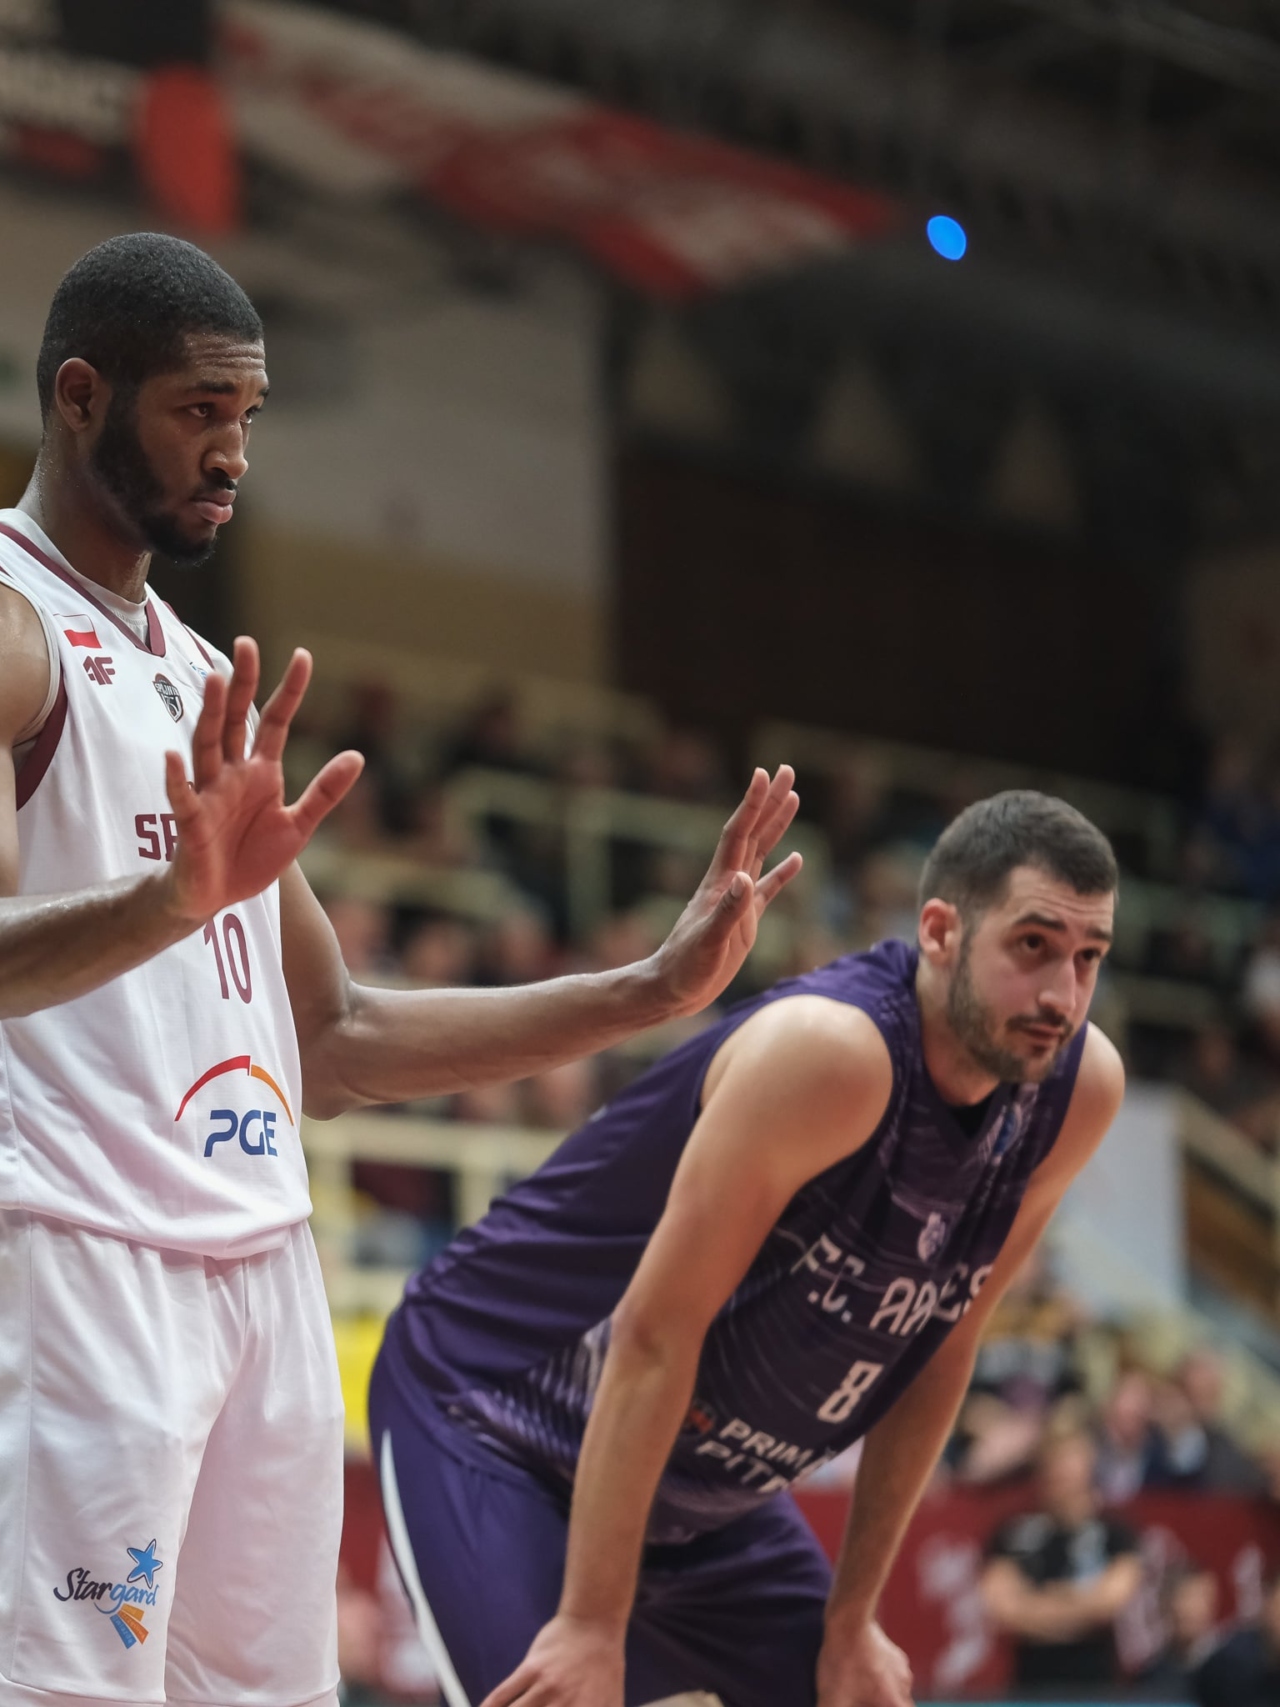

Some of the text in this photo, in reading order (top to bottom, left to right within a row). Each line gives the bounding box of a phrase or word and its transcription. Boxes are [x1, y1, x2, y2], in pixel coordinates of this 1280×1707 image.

[203, 913, 252, 1004] 10
[204, 1109, 278, 1157] PGE
[817, 1360, 884, 1424] 8
[53, 1567, 159, 1614] Stargard
